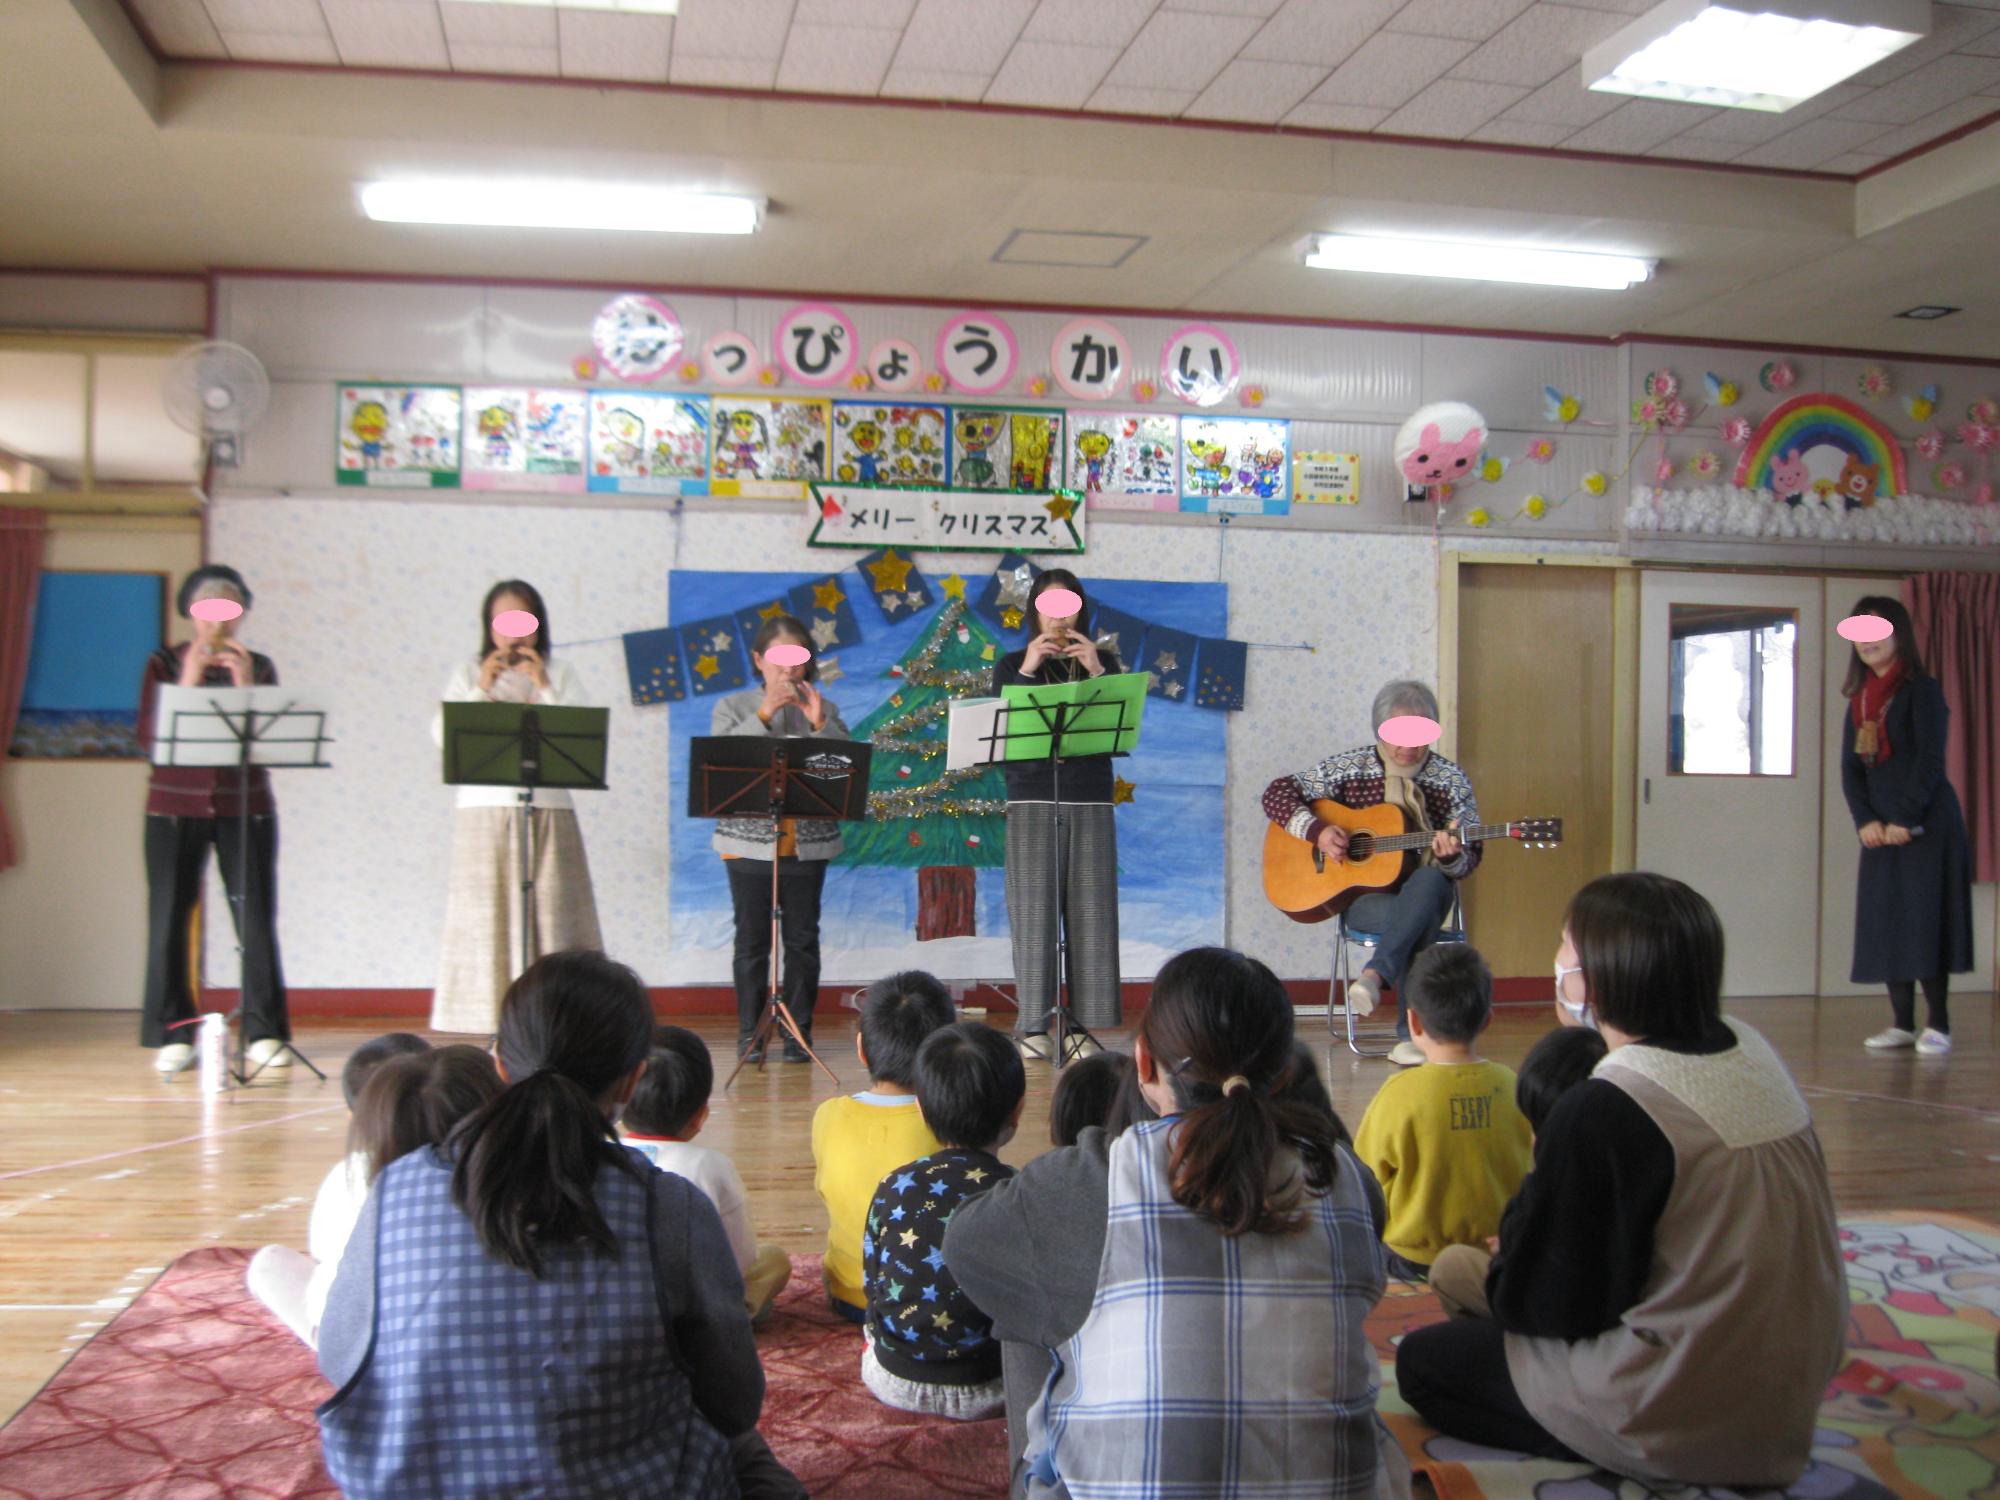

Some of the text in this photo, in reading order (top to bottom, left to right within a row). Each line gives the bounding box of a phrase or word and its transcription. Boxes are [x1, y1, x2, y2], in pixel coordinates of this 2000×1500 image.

[850, 508, 1049, 536] メリー クリスマス
